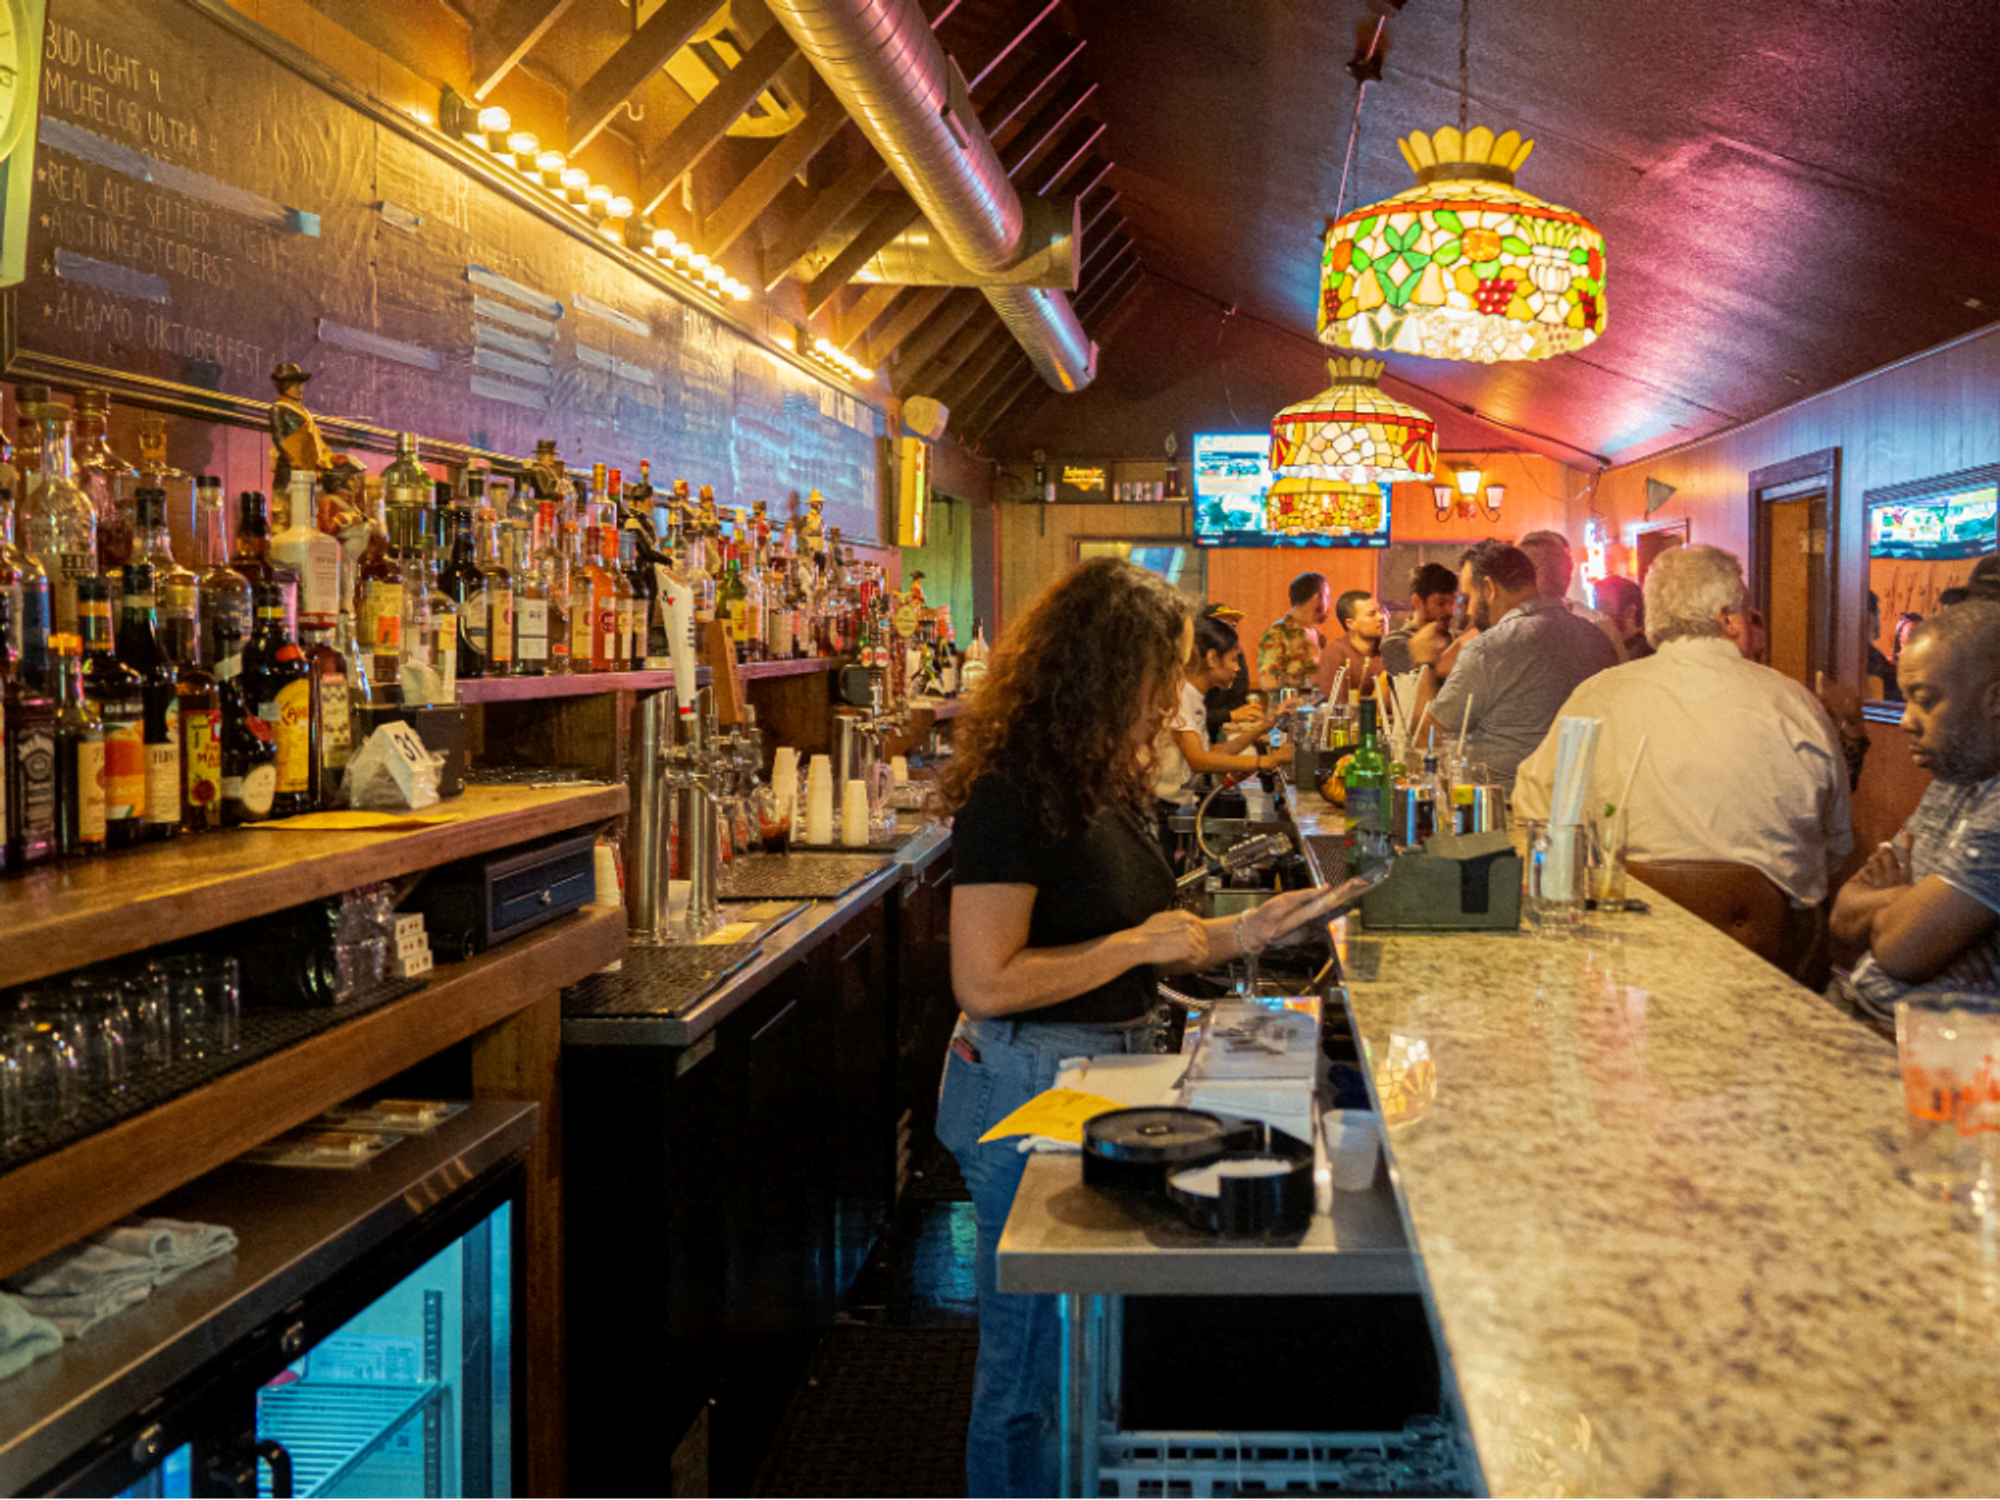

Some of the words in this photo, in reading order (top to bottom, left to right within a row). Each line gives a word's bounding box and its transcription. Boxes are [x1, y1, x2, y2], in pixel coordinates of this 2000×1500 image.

[86, 38, 141, 92] LIGHT
[150, 67, 161, 101] 4
[45, 67, 142, 135] MICHELOB
[148, 110, 199, 156] ULTRA
[48, 160, 98, 209] REAL
[103, 177, 136, 221] ALE
[51, 204, 118, 253] AUSTIN
[54, 290, 135, 341] ALAMO
[394, 732, 424, 761] 31
